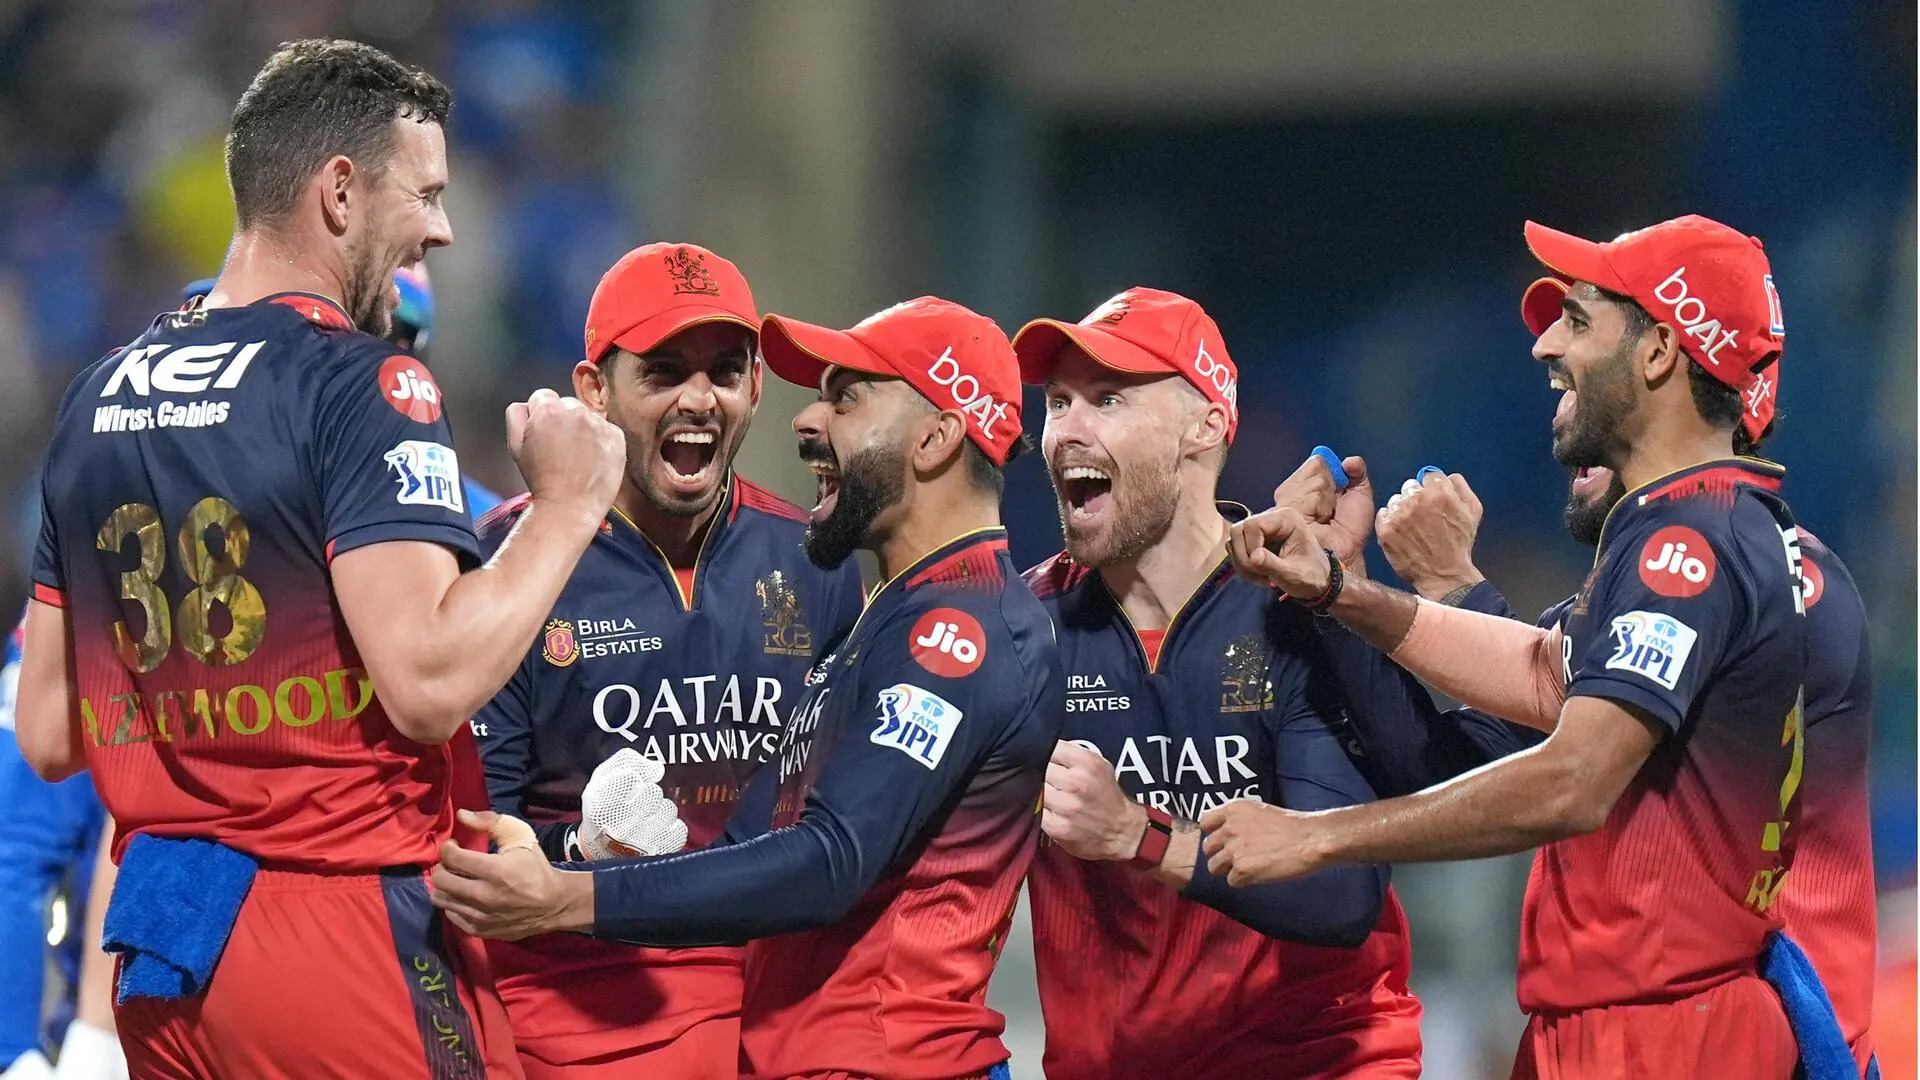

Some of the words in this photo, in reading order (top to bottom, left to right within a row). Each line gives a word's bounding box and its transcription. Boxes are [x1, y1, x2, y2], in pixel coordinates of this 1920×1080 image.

[1653, 265, 1740, 366] boAt
[99, 339, 267, 398] KEI
[391, 369, 437, 405] Jio
[928, 345, 1009, 440] boAt
[156, 400, 231, 429] Cables
[424, 476, 459, 506] IPL
[1645, 542, 1707, 584] Jio
[96, 496, 267, 674] 38
[577, 618, 637, 636] BIRLA
[581, 636, 663, 659] ESTATES
[916, 621, 978, 663] Jio
[1066, 674, 1107, 690] IRLA
[1629, 643, 1673, 684] IPL
[592, 673, 783, 742] QATAR
[1065, 695, 1131, 713] STATES
[896, 720, 939, 764] IPL
